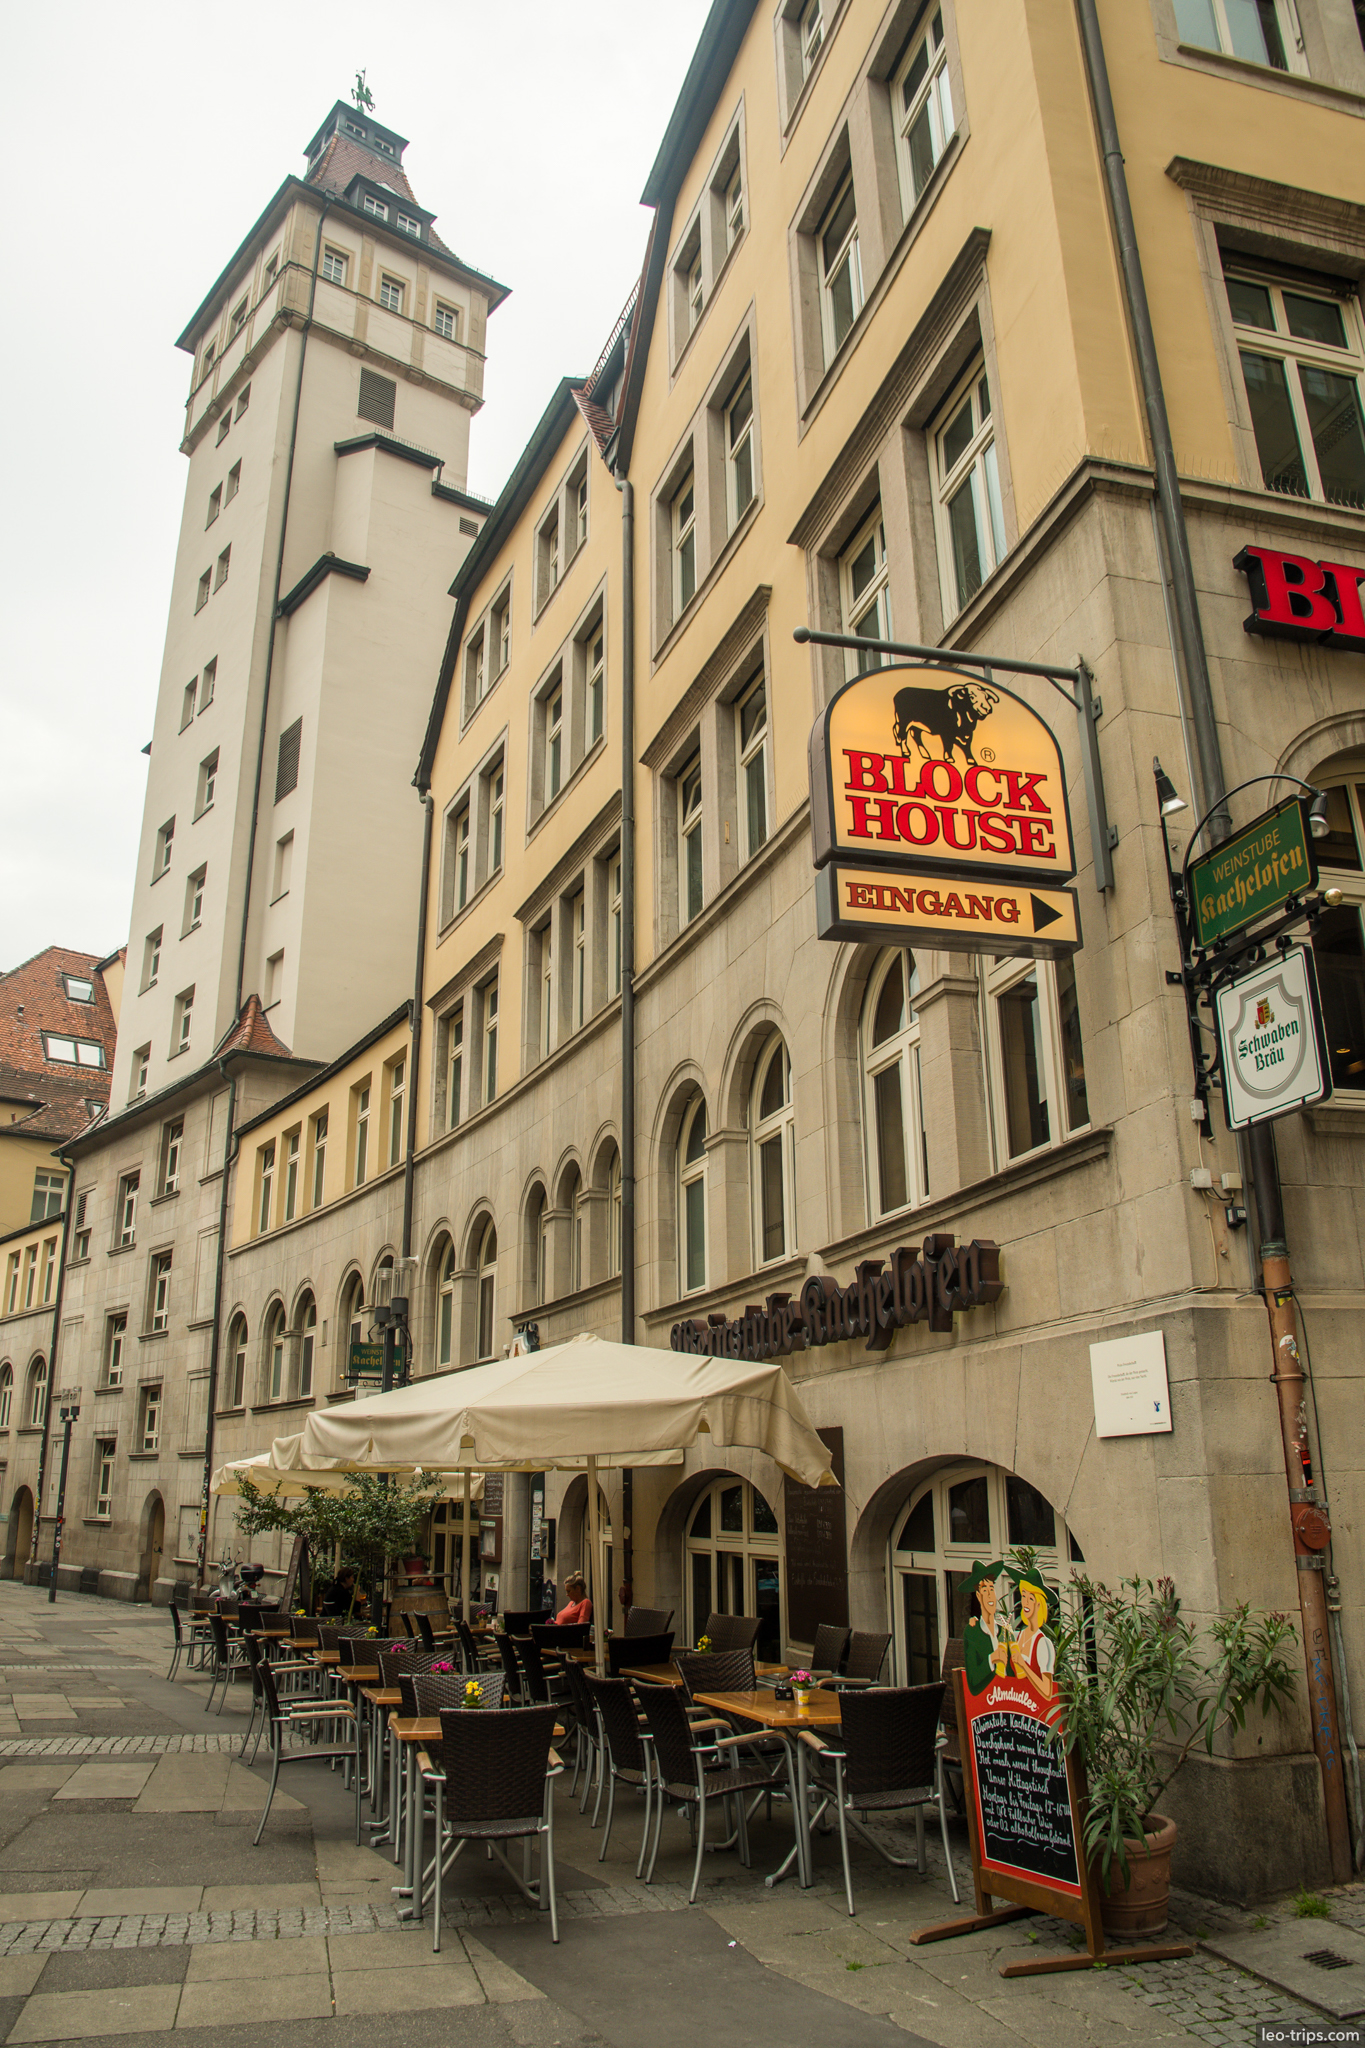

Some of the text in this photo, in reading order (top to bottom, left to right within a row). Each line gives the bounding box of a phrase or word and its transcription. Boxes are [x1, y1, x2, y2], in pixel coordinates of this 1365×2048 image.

[842, 748, 1051, 814] BLOCK
[845, 795, 1057, 859] HOUSE
[1212, 828, 1281, 883] WEINSTUBE
[1201, 845, 1303, 924] Kachelofen
[845, 881, 1021, 923] EINGANG
[1238, 1020, 1299, 1060] Schwaben
[1254, 1047, 1285, 1072] Bräu
[800, 1233, 1004, 1351] Kachelofen
[353, 1355, 400, 1367] Kacheln
[987, 1686, 1037, 1712] Almdudler
[973, 1712, 1047, 1738] Weinstube Kachelofen
[976, 1734, 1014, 1754] Durchgehend
[1016, 1743, 1036, 1756] warme
[977, 1749, 991, 1765] Hot
[993, 1752, 1012, 1768] meals
[1012, 1757, 1030, 1772] served
[985, 1768, 1049, 1794] Unser Mittagstisch
[983, 1784, 1007, 1805] Montags
[1009, 1791, 1019, 1807] bis
[1018, 1791, 1043, 1813] Freitags
[984, 1802, 995, 1815] mit
[1037, 1814, 1053, 1829] Wein
[986, 1816, 999, 1829] oder
